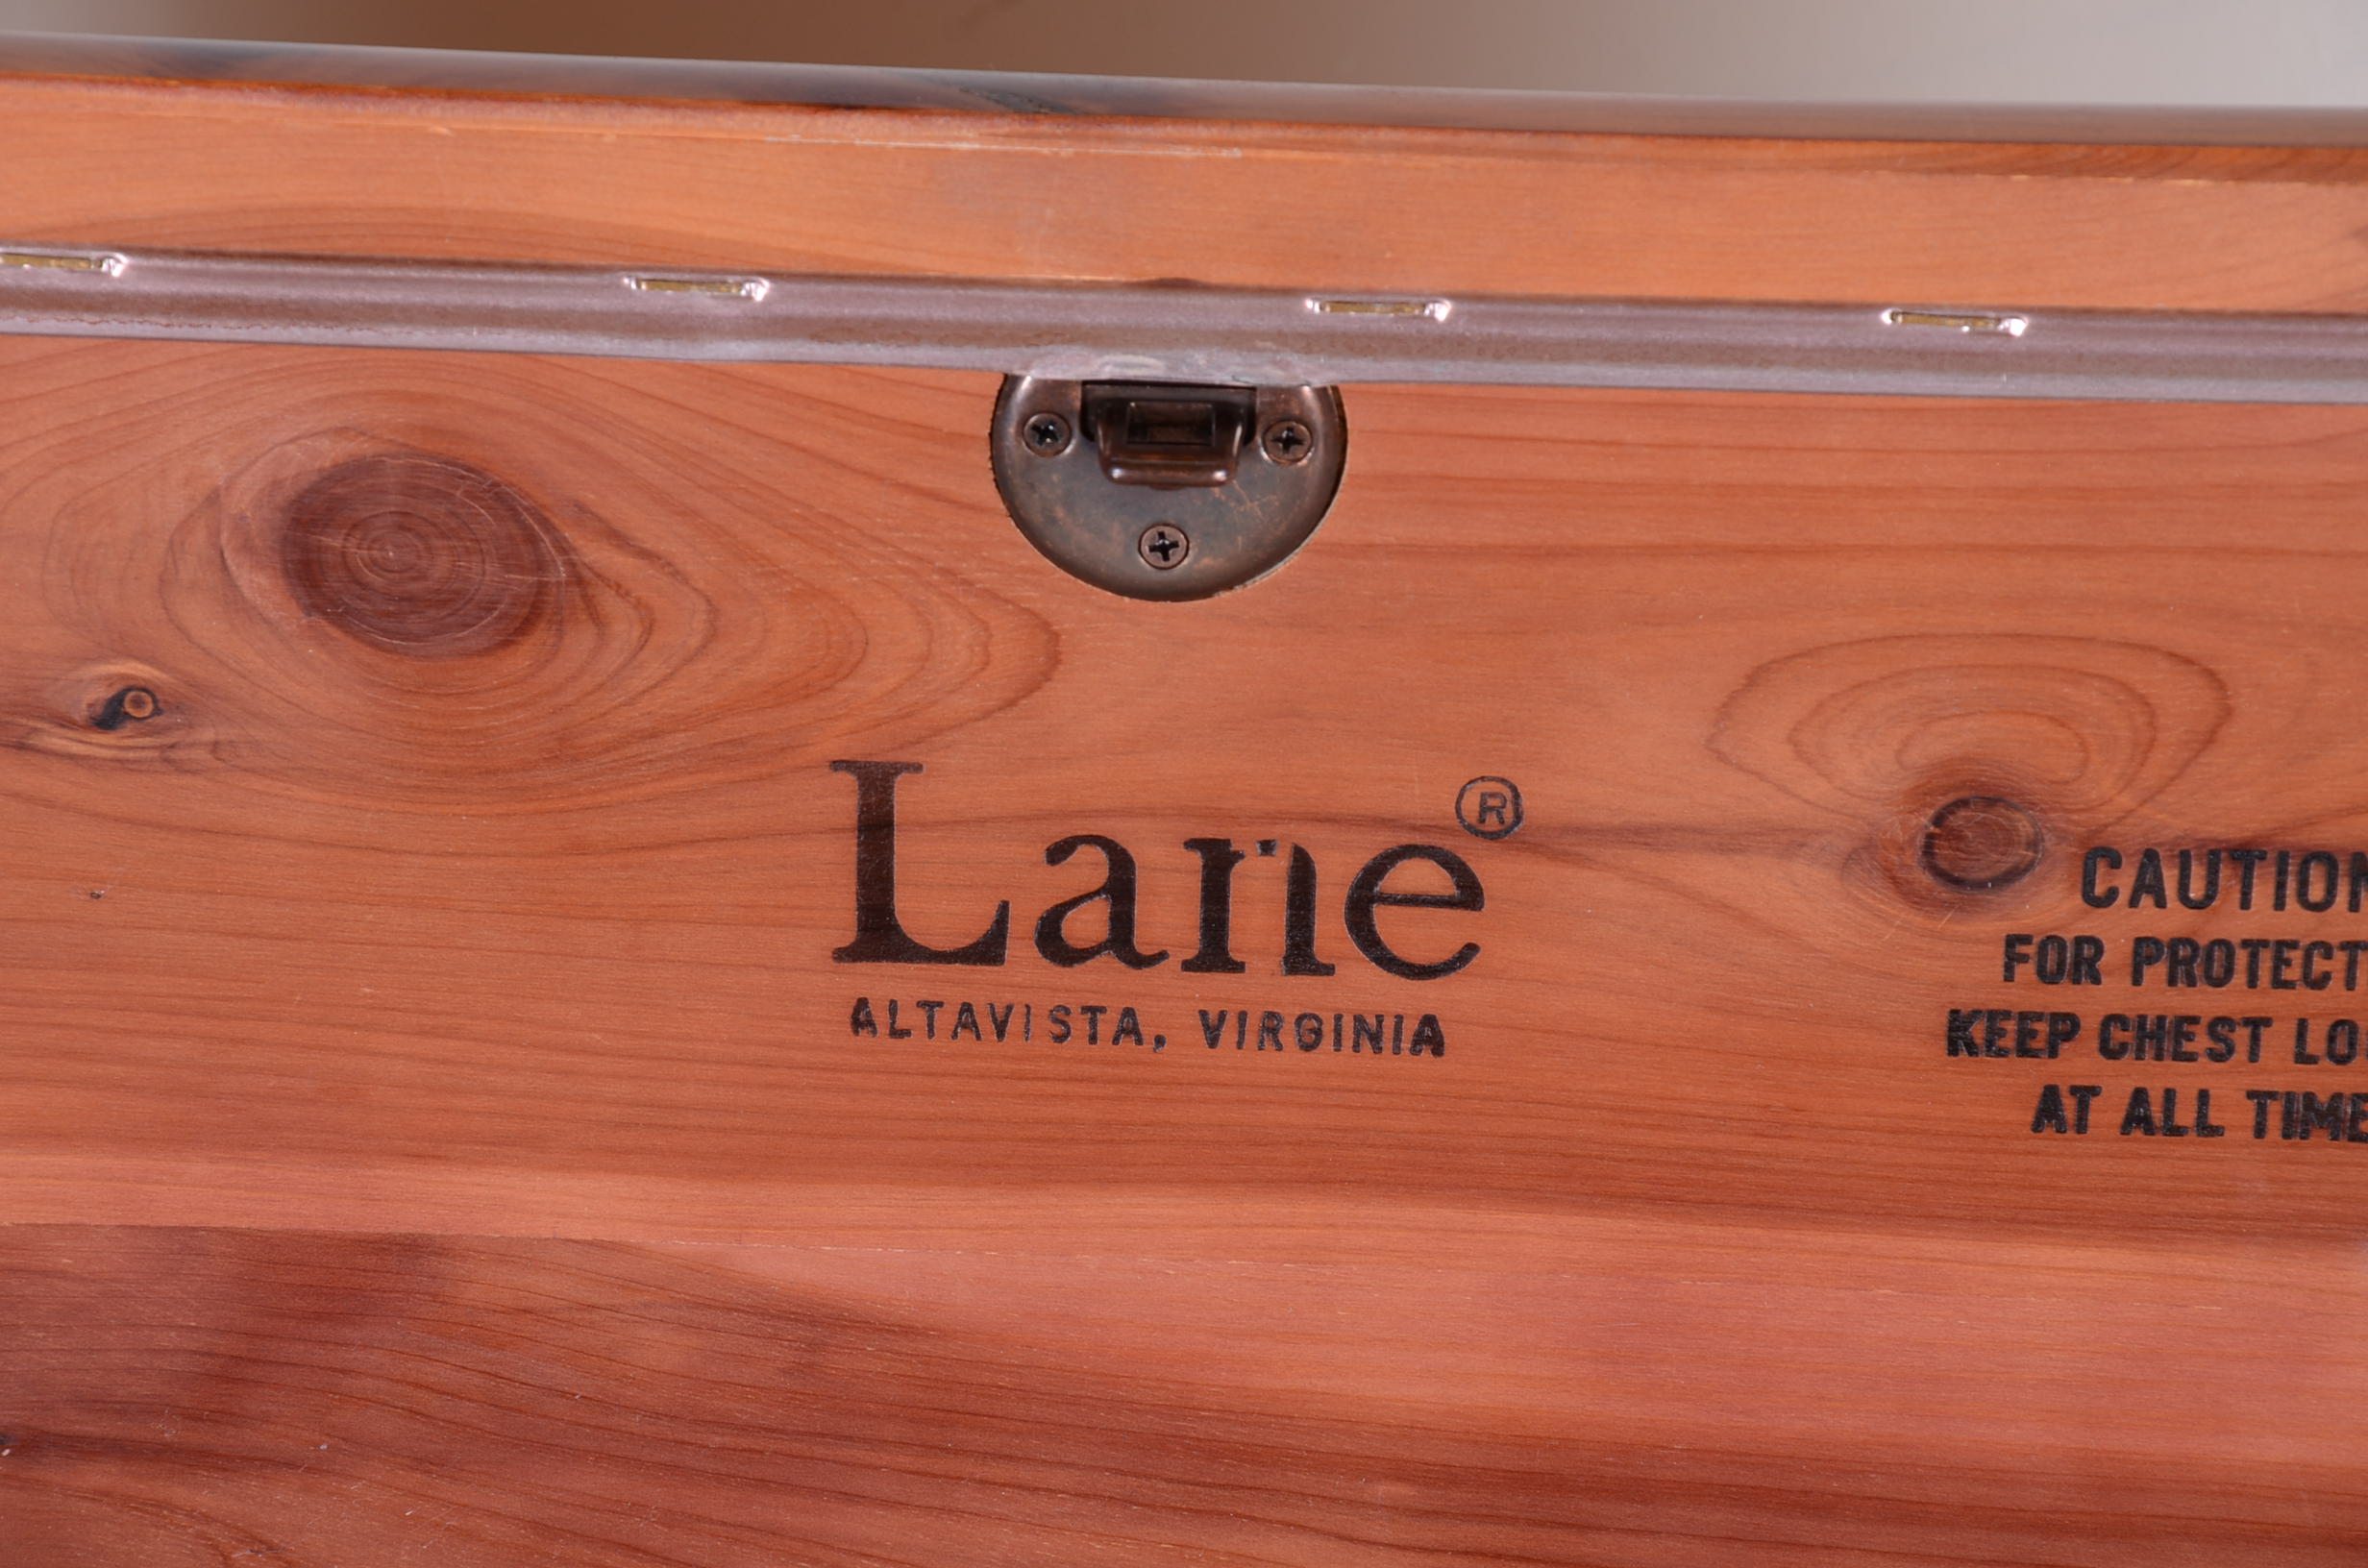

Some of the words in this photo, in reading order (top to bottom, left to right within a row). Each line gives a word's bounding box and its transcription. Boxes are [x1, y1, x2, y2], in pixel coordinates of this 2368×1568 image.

[829, 759, 1485, 981] Lane
[2002, 933, 2106, 986] FOR
[850, 997, 1167, 1052] ALTAVISTA,
[1197, 1008, 1446, 1057] VIRGINIA
[1945, 1008, 2082, 1060] KEEP
[2097, 1012, 2274, 1064] CHEST
[2292, 1017, 2368, 1066] LO
[2030, 1083, 2104, 1136] AT
[2119, 1087, 2226, 1139] ALL
